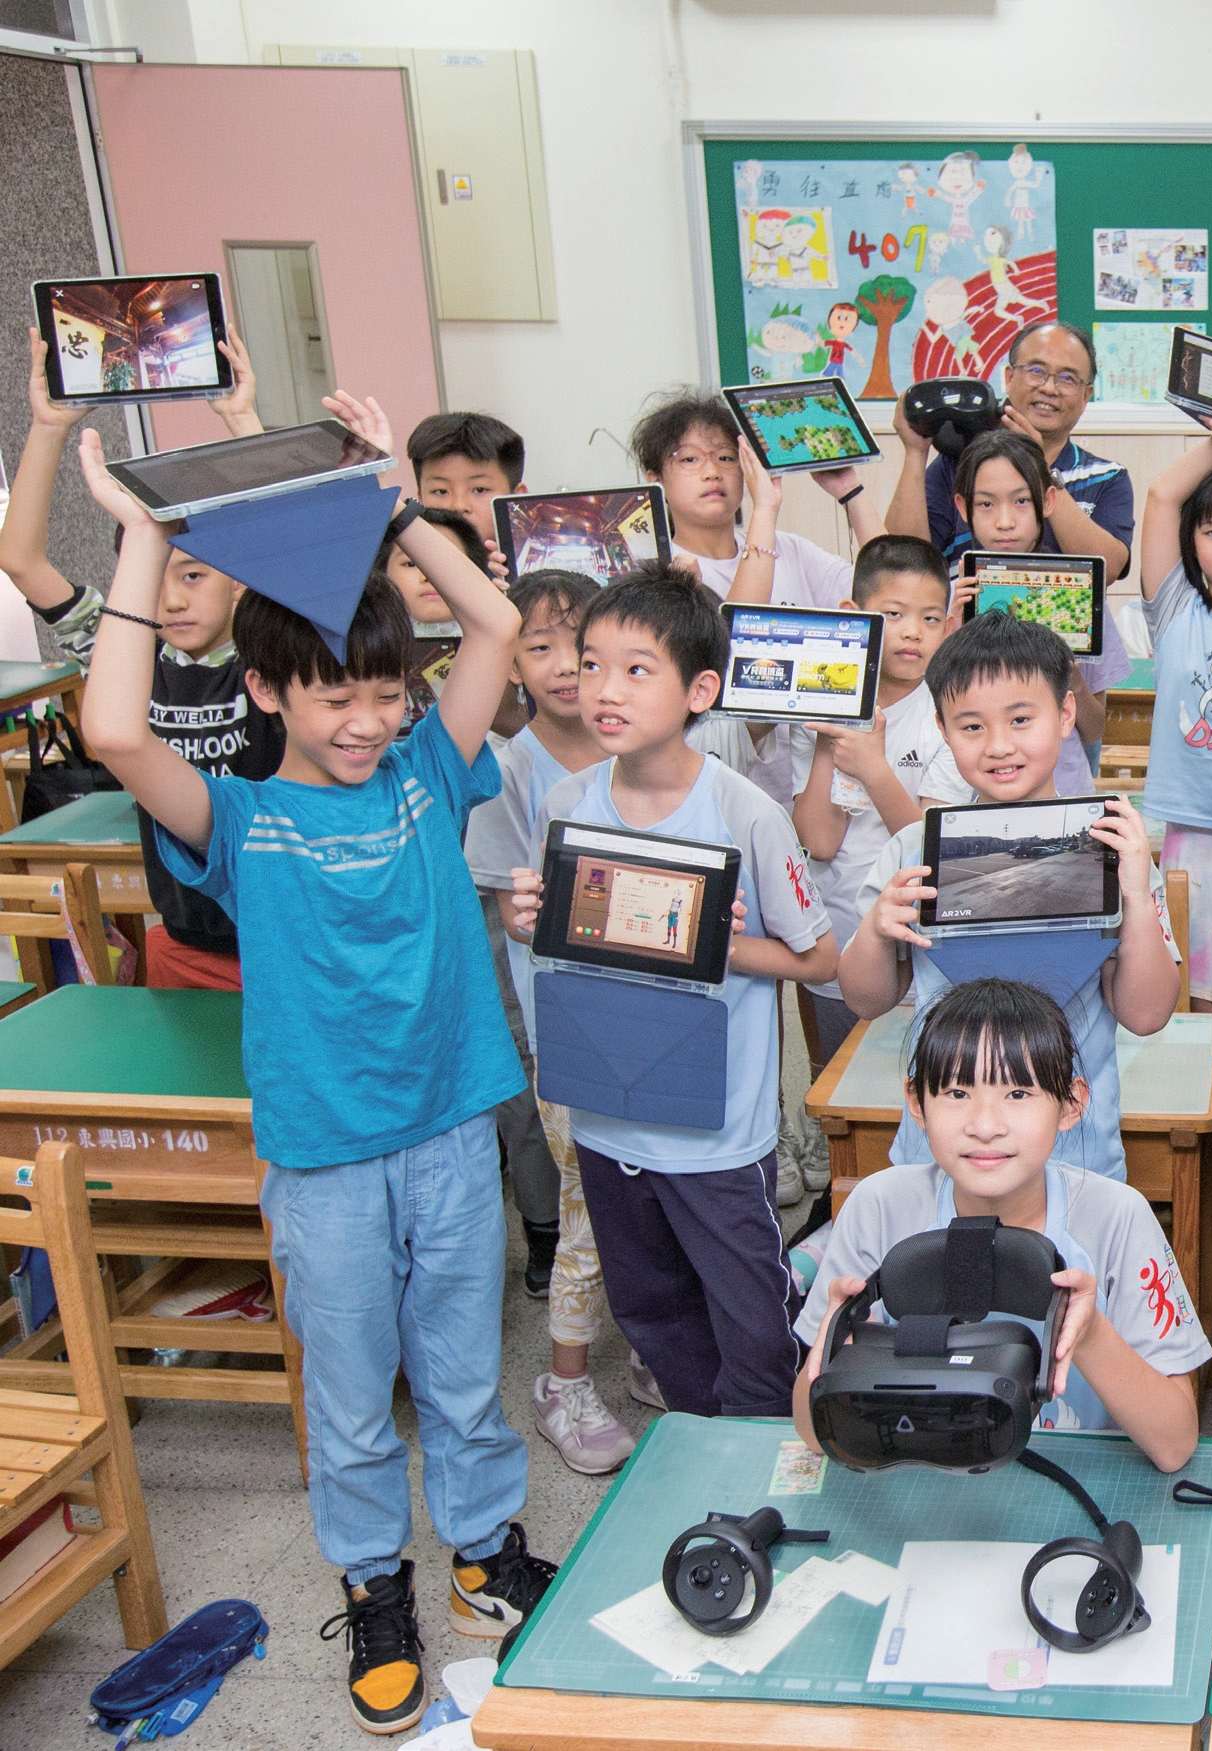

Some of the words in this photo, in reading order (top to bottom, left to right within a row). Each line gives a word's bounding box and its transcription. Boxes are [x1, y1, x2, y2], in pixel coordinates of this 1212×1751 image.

[762, 169, 893, 200] 勇往直前
[848, 223, 929, 273] 407
[61, 329, 90, 360] 忠
[897, 760, 923, 768] adidas
[941, 909, 972, 918] AR2VR
[78, 1127, 156, 1150] 東興國小
[161, 1128, 210, 1153] 140
